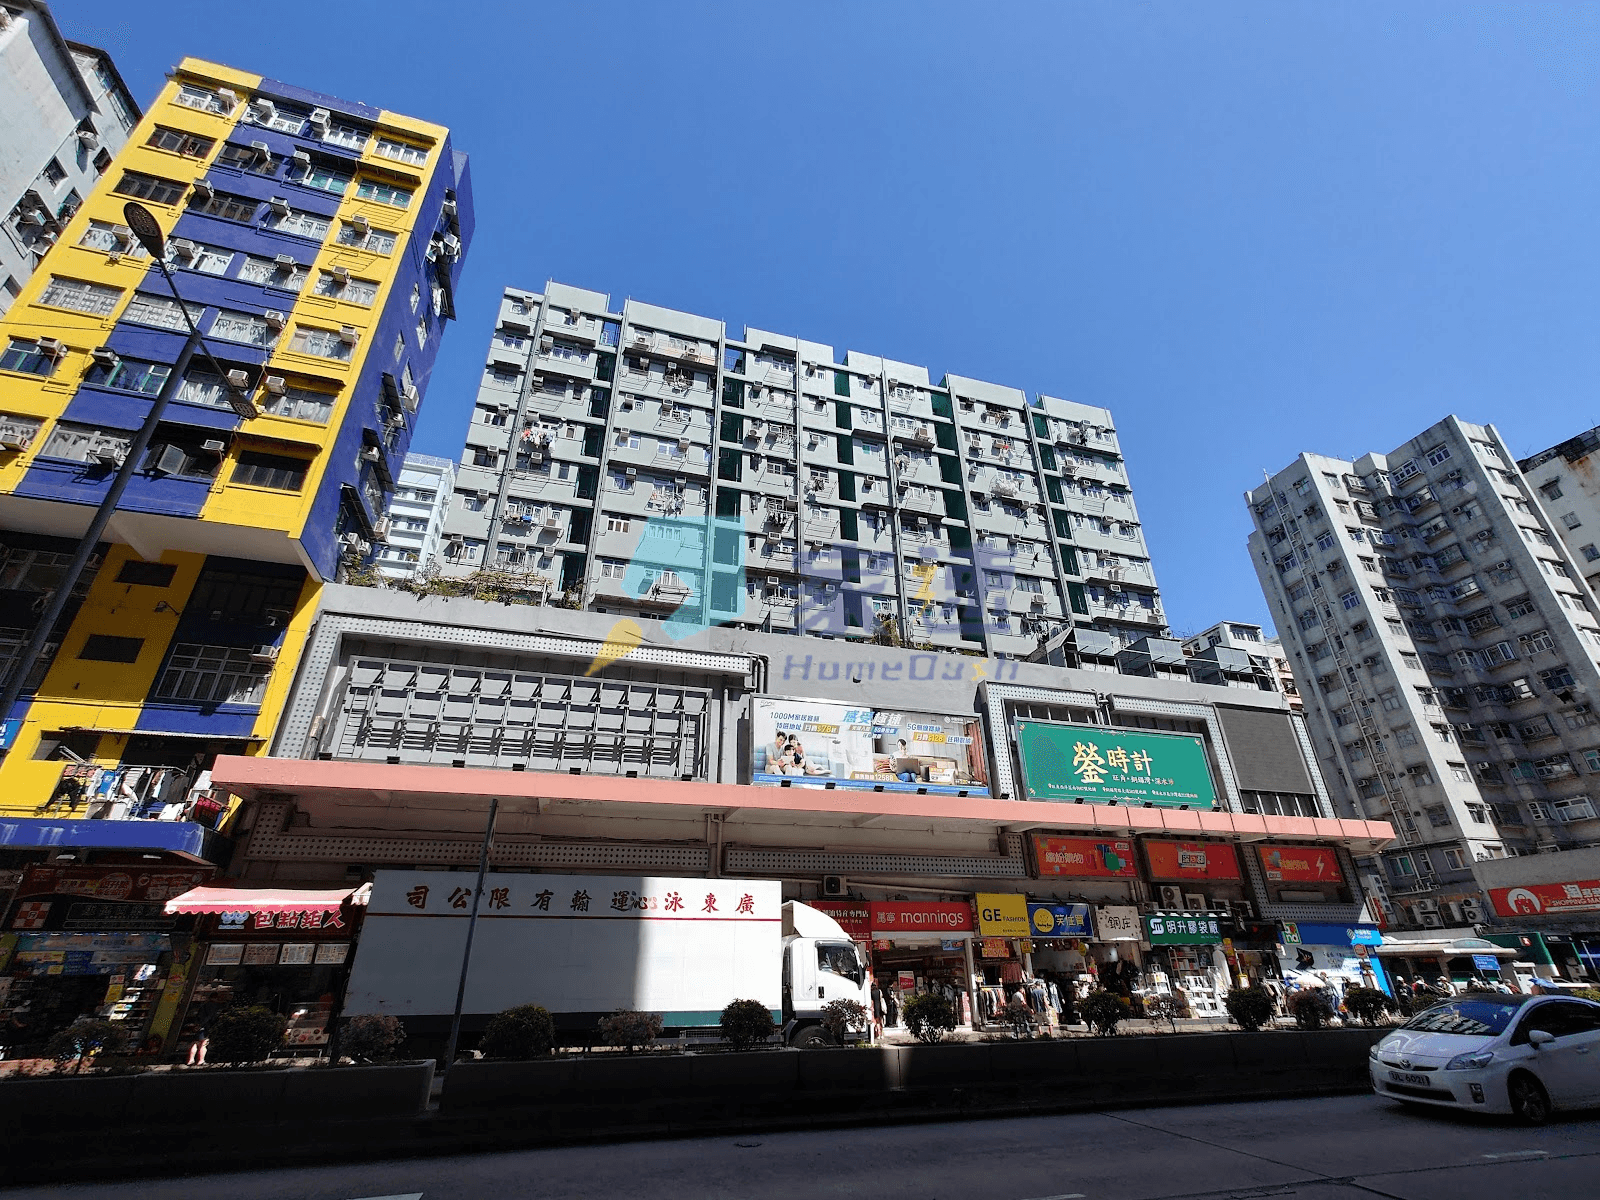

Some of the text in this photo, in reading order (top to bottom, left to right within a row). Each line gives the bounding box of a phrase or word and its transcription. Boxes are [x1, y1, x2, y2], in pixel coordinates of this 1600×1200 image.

[900, 910, 964, 927] mannings
[982, 908, 1026, 923] GE FASHION
